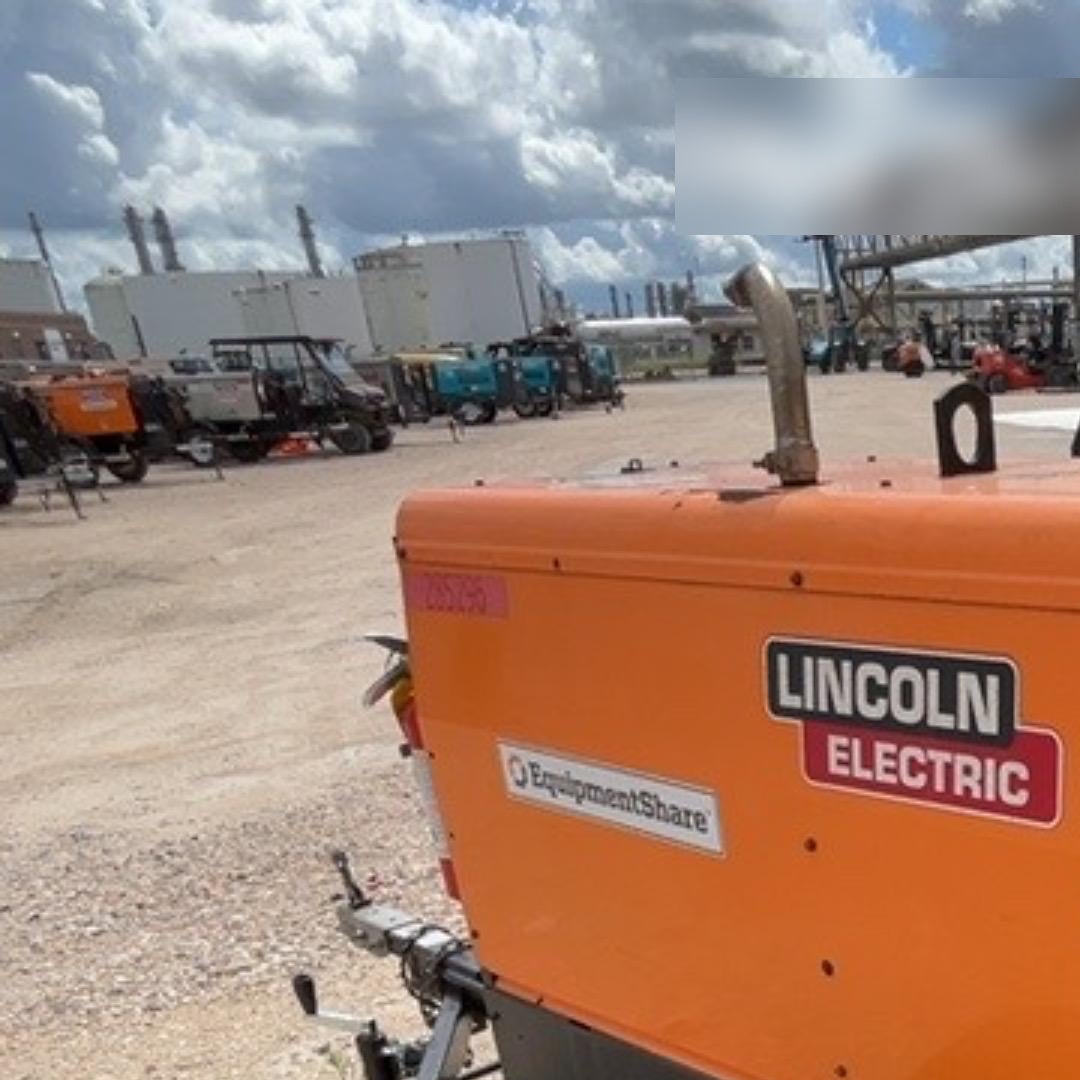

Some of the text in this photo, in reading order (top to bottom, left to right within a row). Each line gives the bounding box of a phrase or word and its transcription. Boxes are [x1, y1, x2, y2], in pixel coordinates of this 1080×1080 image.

[776, 653, 1000, 735] LINCOLN
[528, 761, 709, 833] EquipmentShare
[827, 734, 1030, 806] ELECTRIC
